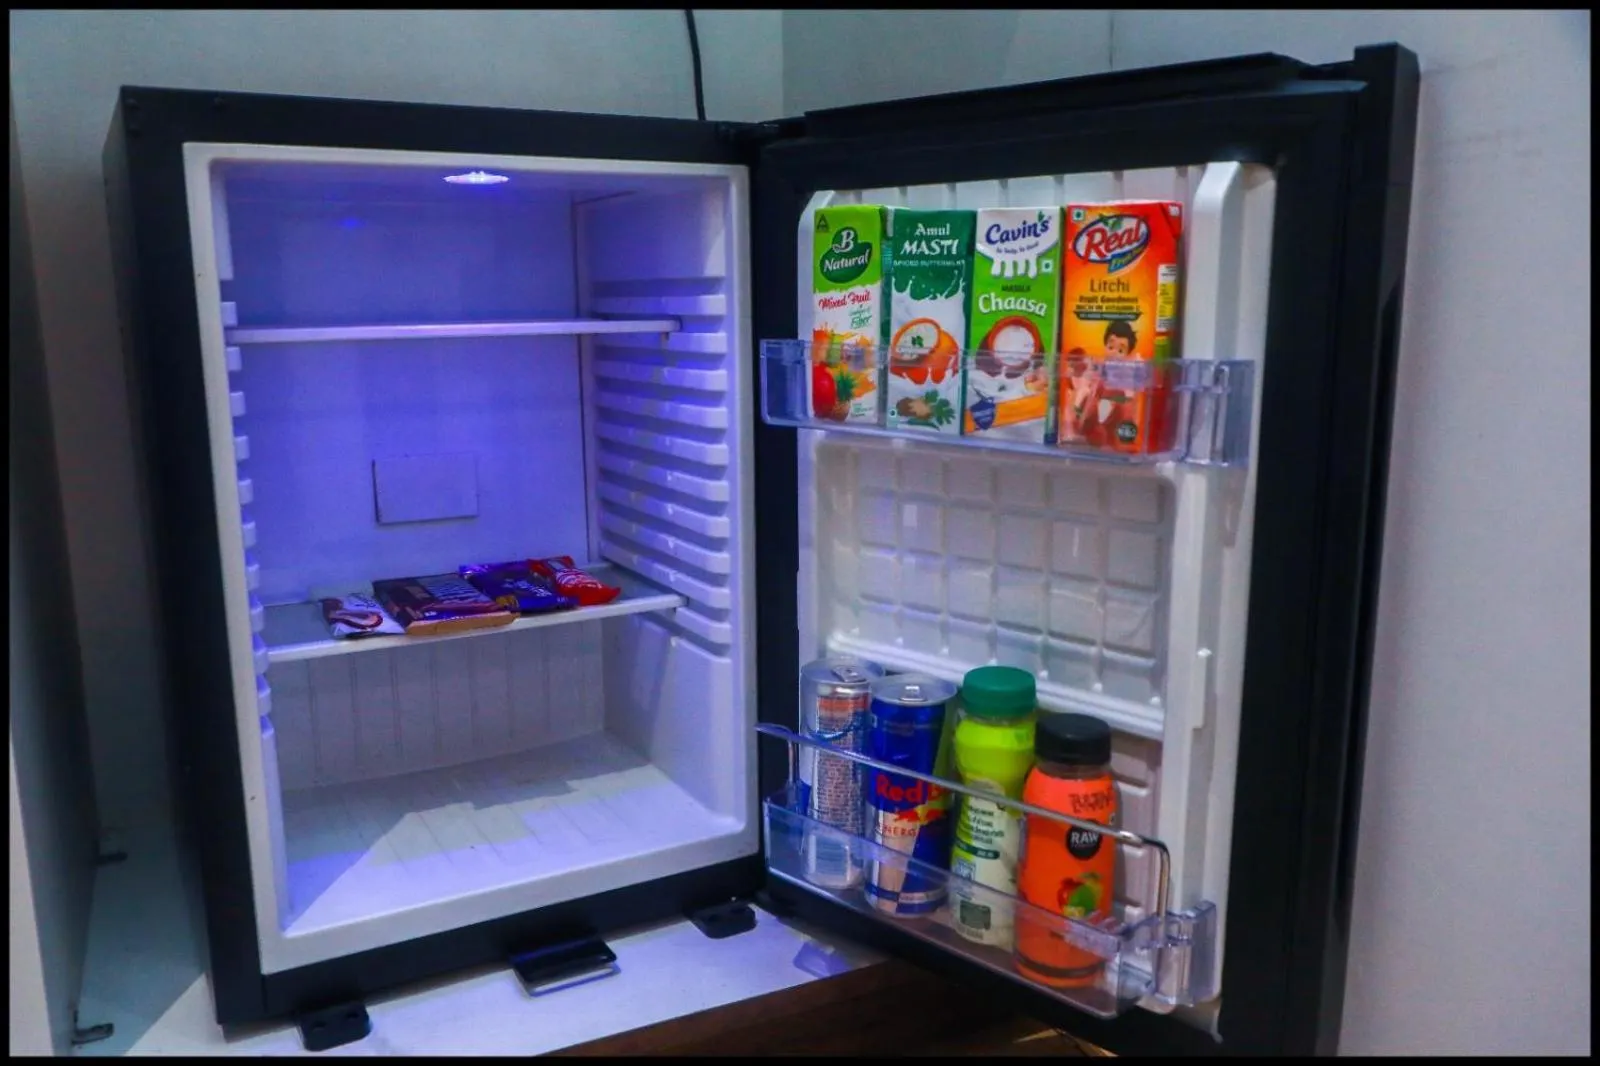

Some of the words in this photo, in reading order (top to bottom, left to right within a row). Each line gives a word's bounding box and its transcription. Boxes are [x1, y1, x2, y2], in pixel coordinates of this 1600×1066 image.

[914, 223, 950, 236] Amul
[985, 219, 1049, 245] Cavin's
[832, 230, 854, 252] B
[900, 239, 959, 256] MASTI
[1083, 219, 1140, 263] Real
[823, 249, 869, 271] Natural
[1090, 278, 1131, 293] Litchi
[819, 294, 847, 310] Mixed
[848, 290, 871, 305] Fruit
[978, 292, 1048, 317] Chaasa
[876, 773, 923, 802] Red
[1071, 831, 1099, 845] RAW
